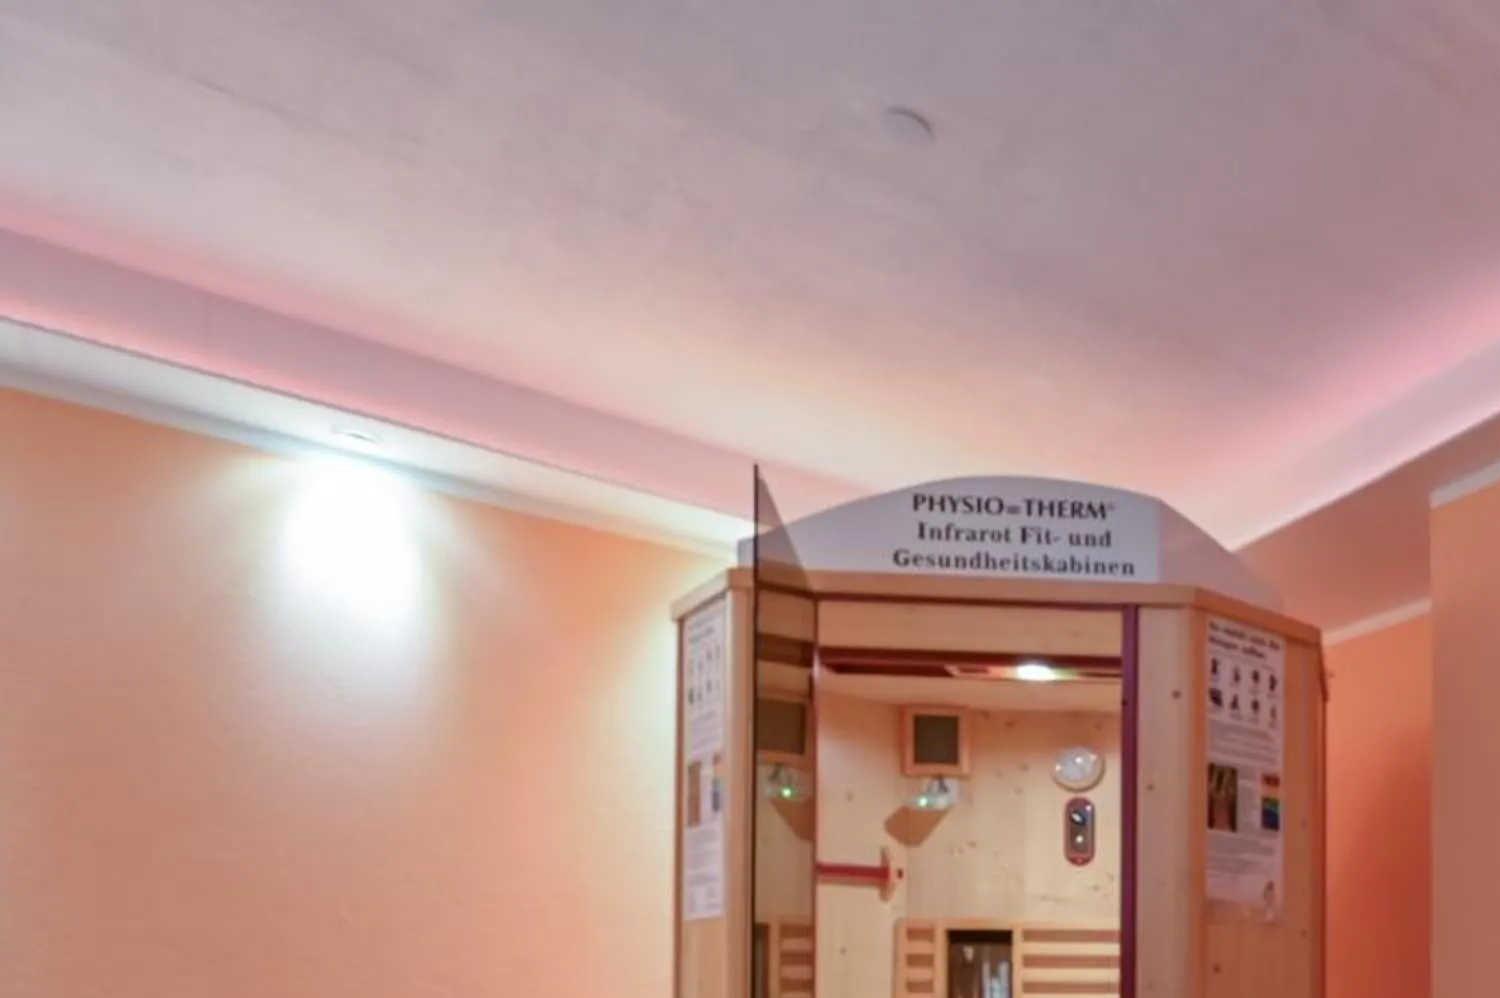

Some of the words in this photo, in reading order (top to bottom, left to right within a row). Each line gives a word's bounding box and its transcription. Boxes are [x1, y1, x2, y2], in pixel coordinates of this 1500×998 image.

[917, 521, 1011, 544] Infrarot
[1019, 525, 1061, 546] Fit-
[1068, 530, 1112, 548] und
[892, 548, 1135, 576] Gesundheitskabinen
